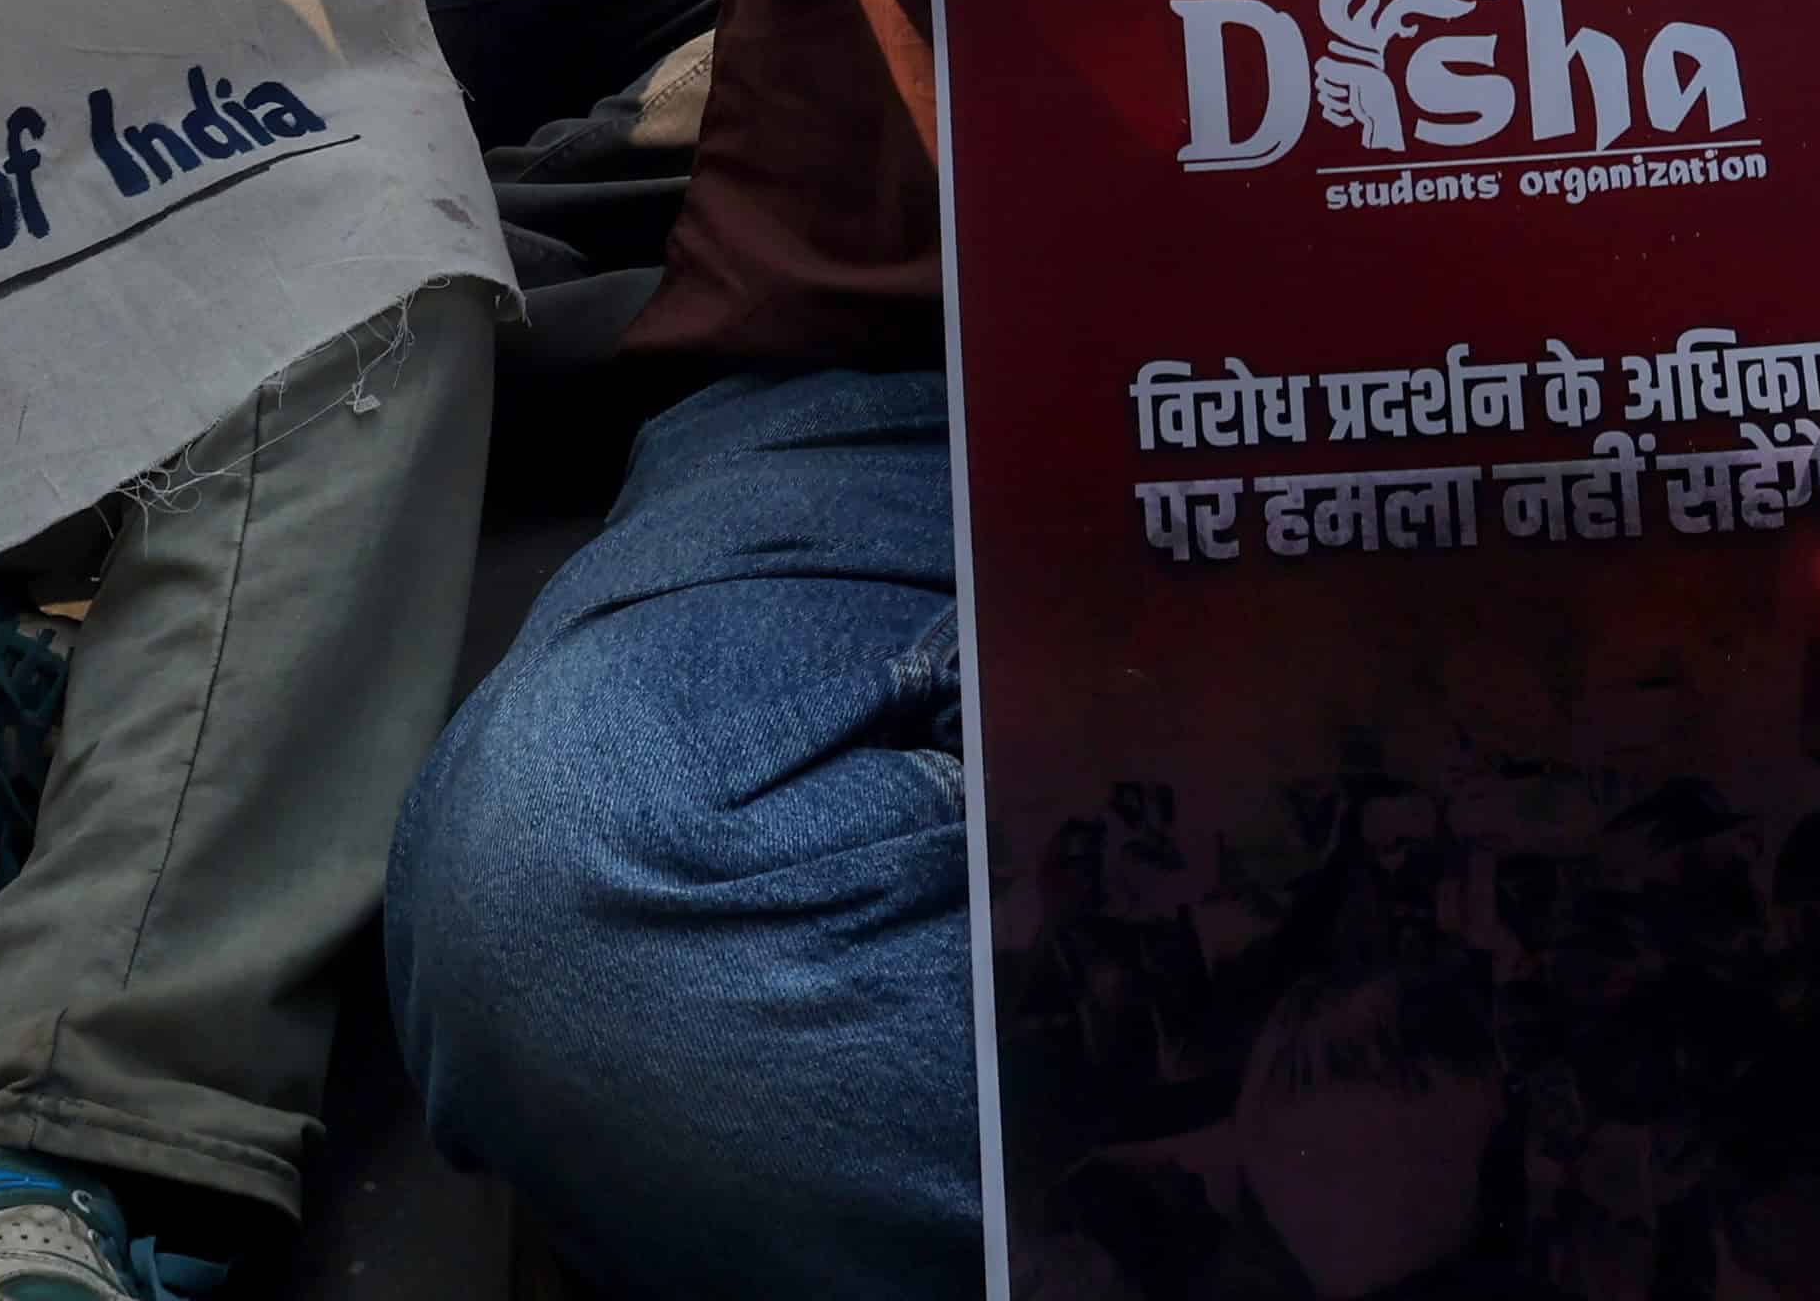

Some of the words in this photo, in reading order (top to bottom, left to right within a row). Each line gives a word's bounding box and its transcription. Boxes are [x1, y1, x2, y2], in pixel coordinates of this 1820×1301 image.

[88, 65, 327, 199] India
[1520, 148, 1769, 204] organization
[1129, 355, 1312, 453] विरोध
[1319, 344, 1529, 443] प्रदर्शन
[1535, 339, 1605, 428] के
[1135, 476, 1241, 564] पर
[1253, 465, 1483, 557] हमला
[1491, 432, 1658, 542] नहीं
